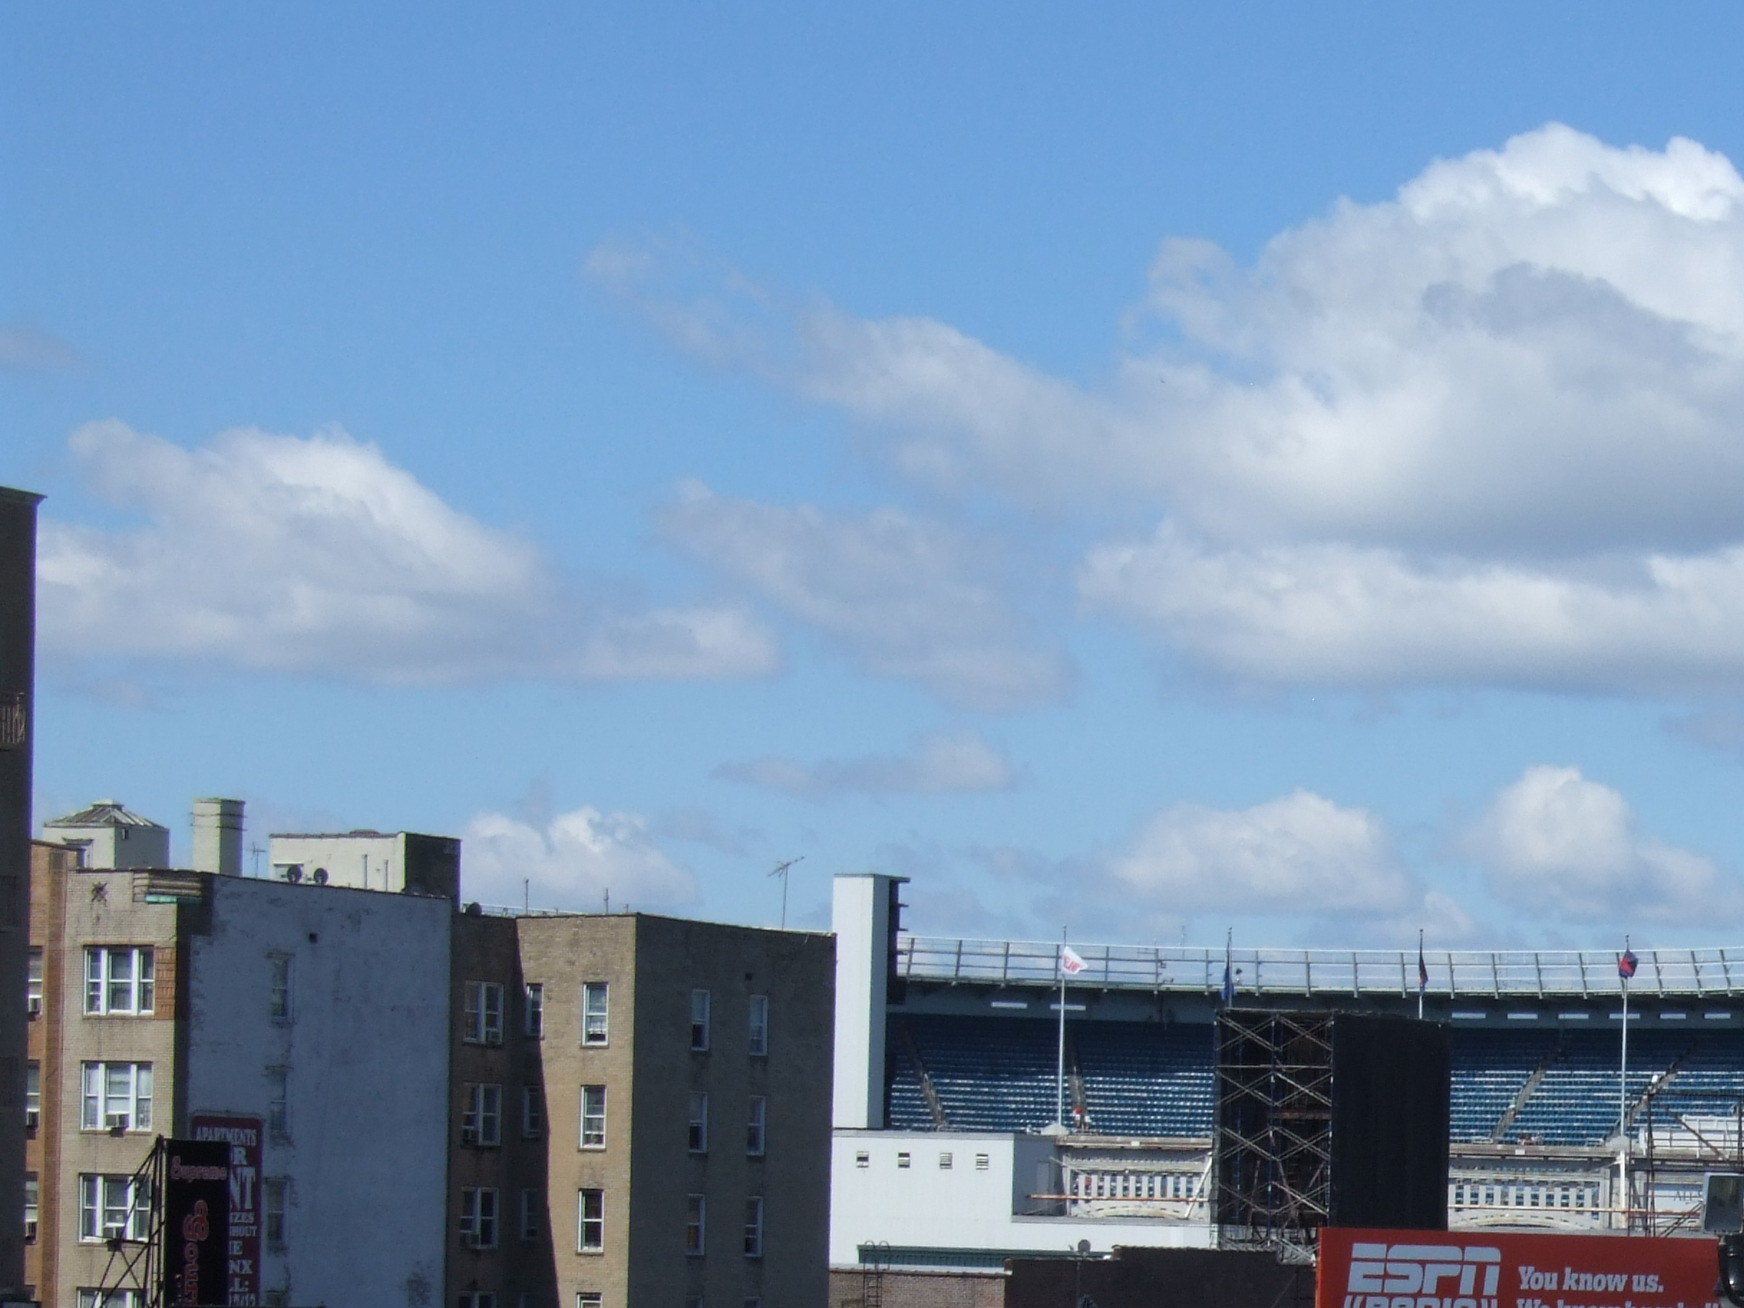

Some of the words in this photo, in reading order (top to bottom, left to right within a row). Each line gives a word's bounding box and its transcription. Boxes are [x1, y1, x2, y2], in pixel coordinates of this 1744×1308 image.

[1347, 1243, 1501, 1295] ESPN
[1518, 1266, 1558, 1292] You
[1563, 1266, 1628, 1293] know
[1632, 1273, 1664, 1294] us.
